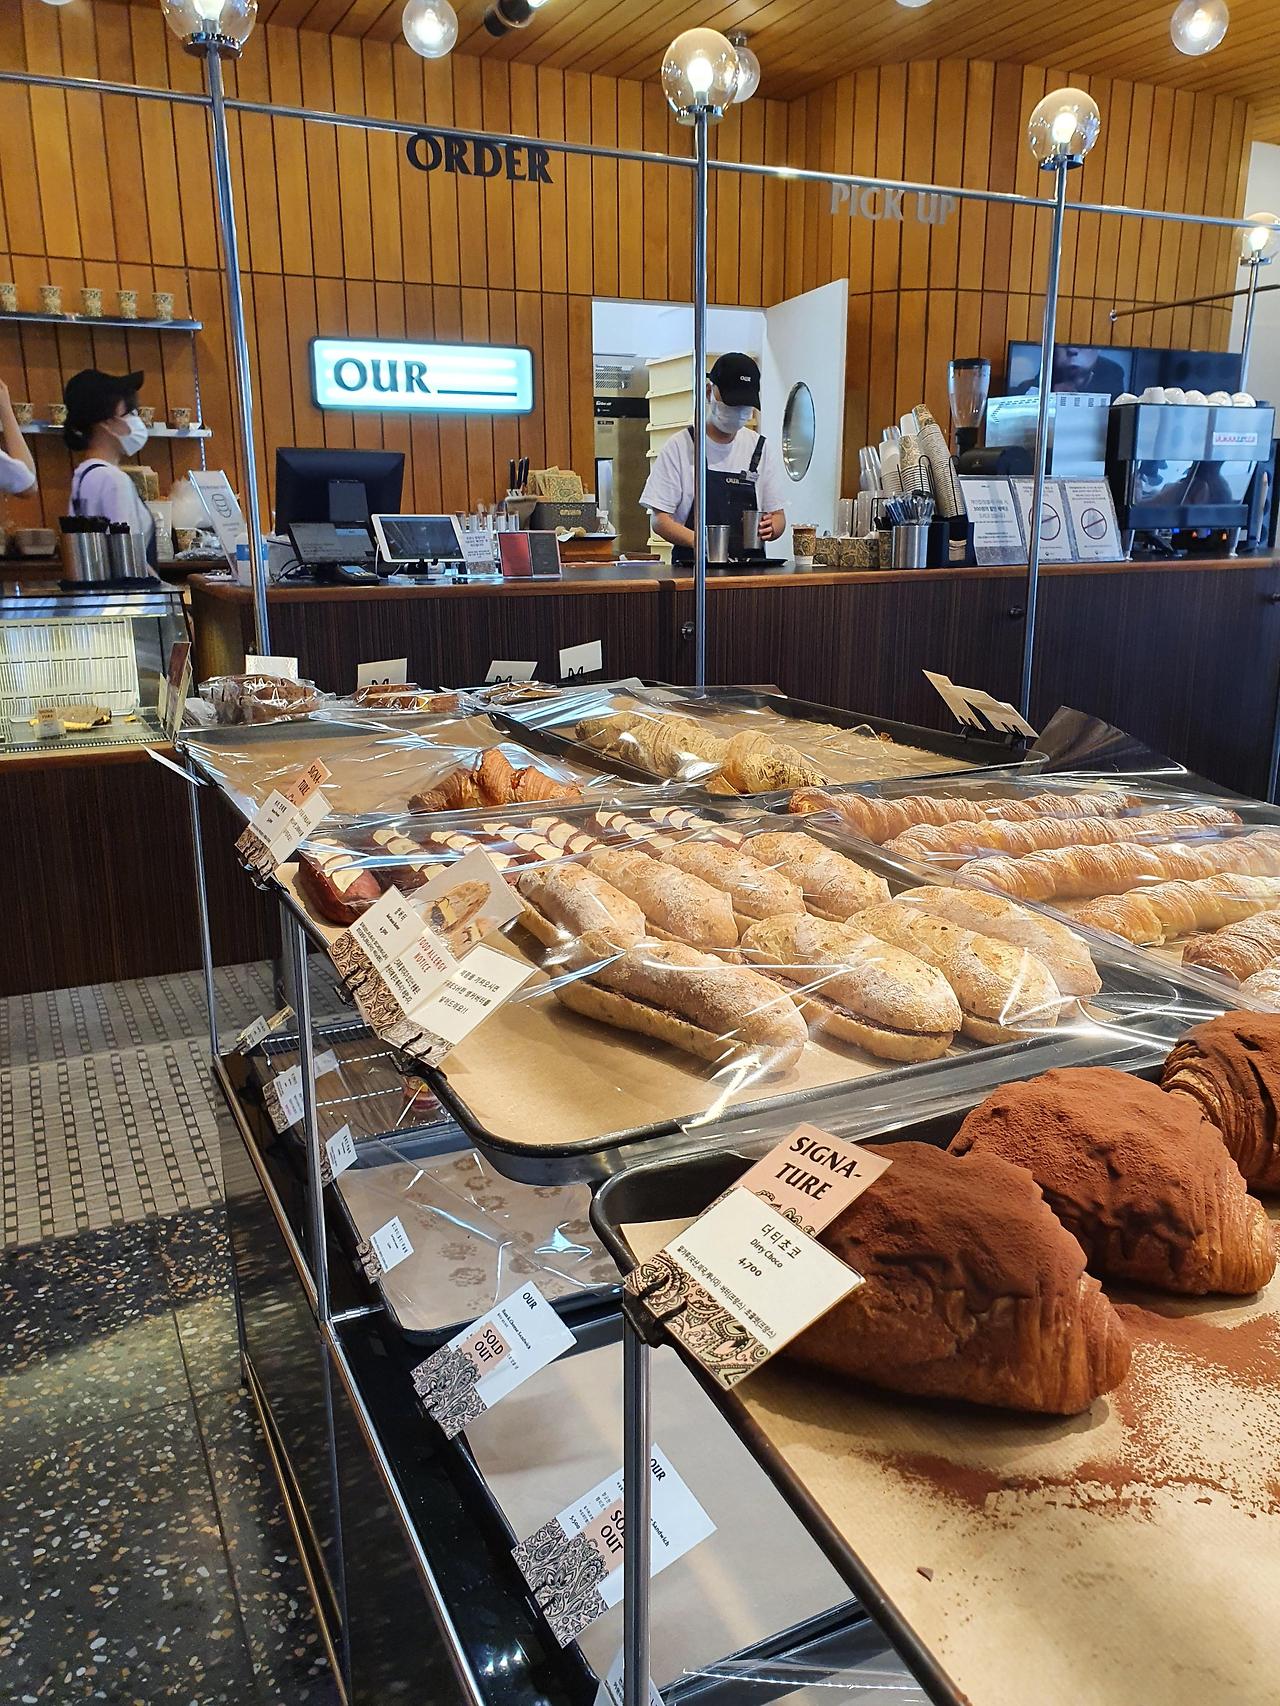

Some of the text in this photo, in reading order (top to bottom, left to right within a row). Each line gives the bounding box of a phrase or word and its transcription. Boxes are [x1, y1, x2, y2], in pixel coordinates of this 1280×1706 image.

[406, 132, 554, 184] ORDER
[831, 182, 957, 225] PICK UP
[333, 357, 431, 394] OUR
[413, 951, 432, 973] NOTICE
[417, 936, 448, 973] FOOD ALLERGY
[789, 1136, 864, 1180] SIGNA-
[774, 1162, 833, 1201] TURE
[750, 1238, 783, 1268] Dirty Choco
[761, 1223, 802, 1260] 더티초코
[738, 1257, 763, 1277] 4,700
[522, 1292, 538, 1310] OUR
[474, 1341, 494, 1363] OUT
[482, 1328, 504, 1356] SOLD
[650, 1458, 667, 1482] OUR
[600, 1525, 624, 1554] OUT
[651, 1520, 671, 1547] Sandwich
